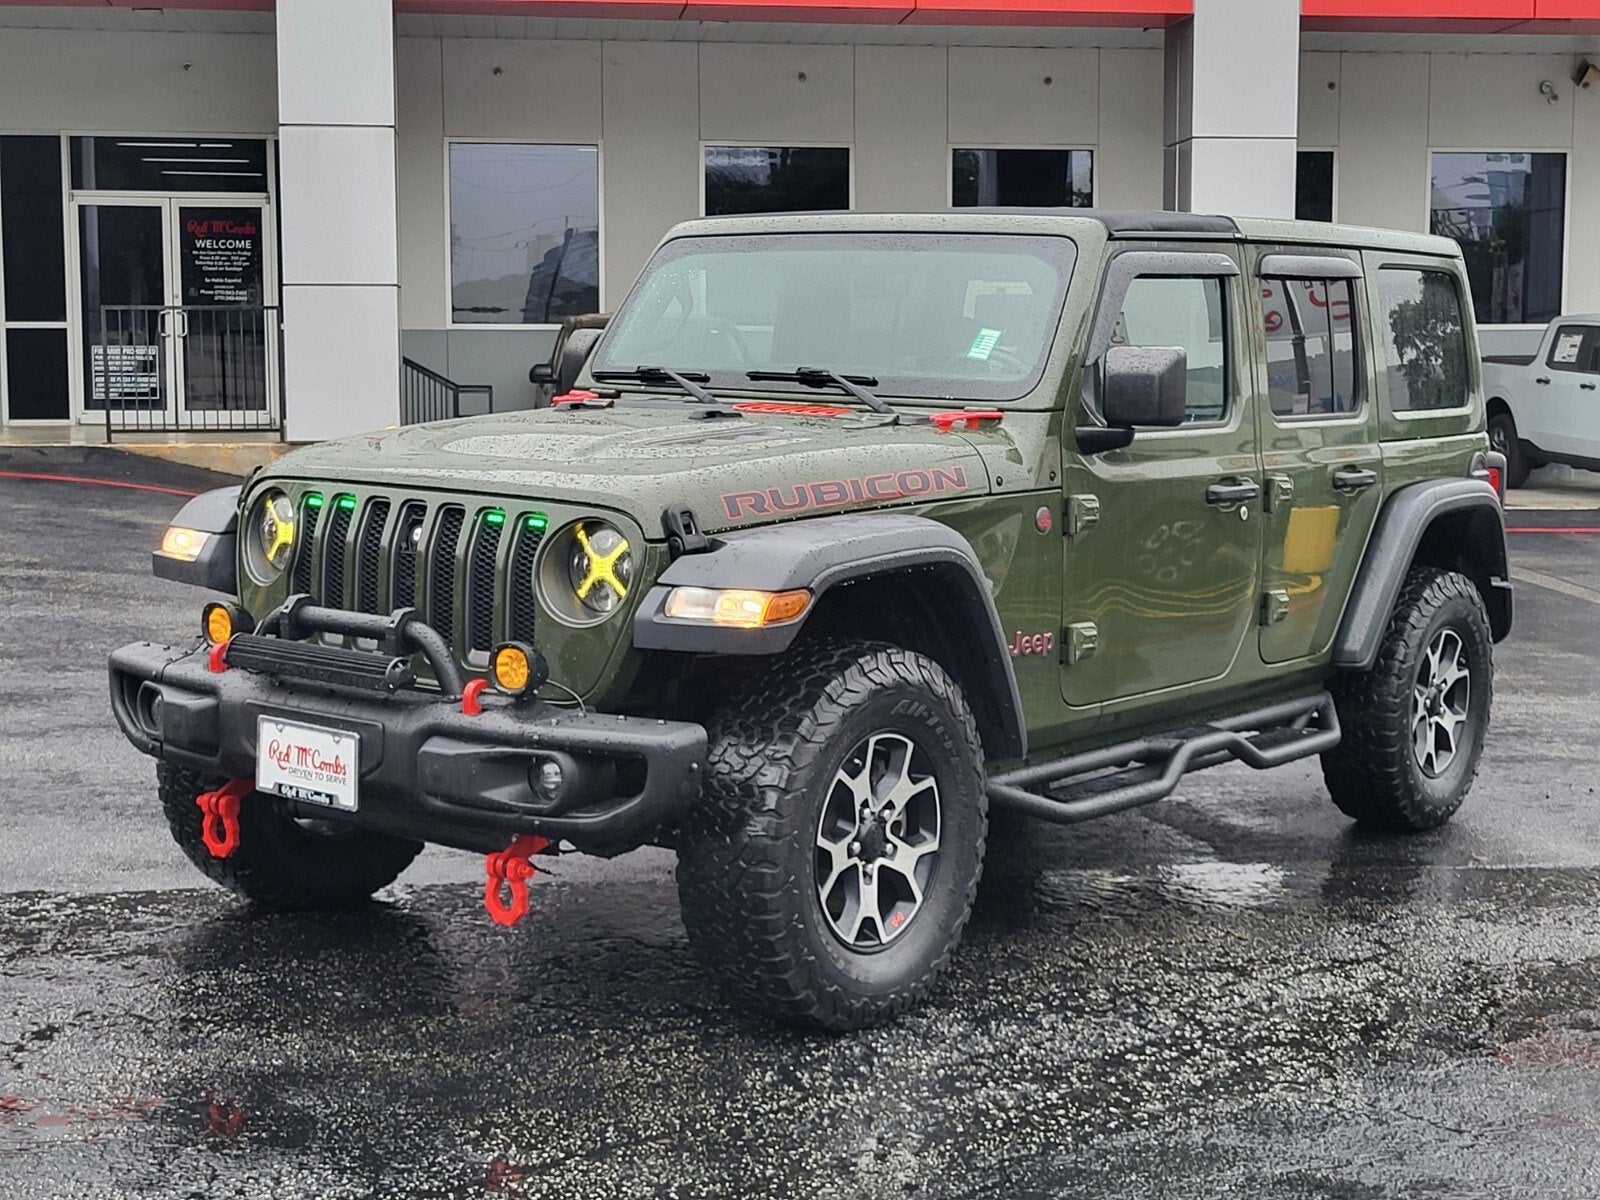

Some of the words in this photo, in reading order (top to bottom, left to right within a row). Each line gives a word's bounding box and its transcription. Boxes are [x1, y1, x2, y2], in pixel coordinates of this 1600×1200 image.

[195, 239, 252, 249] WELCOME
[721, 465, 968, 520] RUBICON
[1008, 630, 1054, 658] Jeep
[268, 739, 292, 771] Red
[294, 744, 347, 776] McCombs
[288, 766, 313, 779] DRIVEN
[314, 772, 325, 781] TO
[325, 774, 347, 786] SERVE
